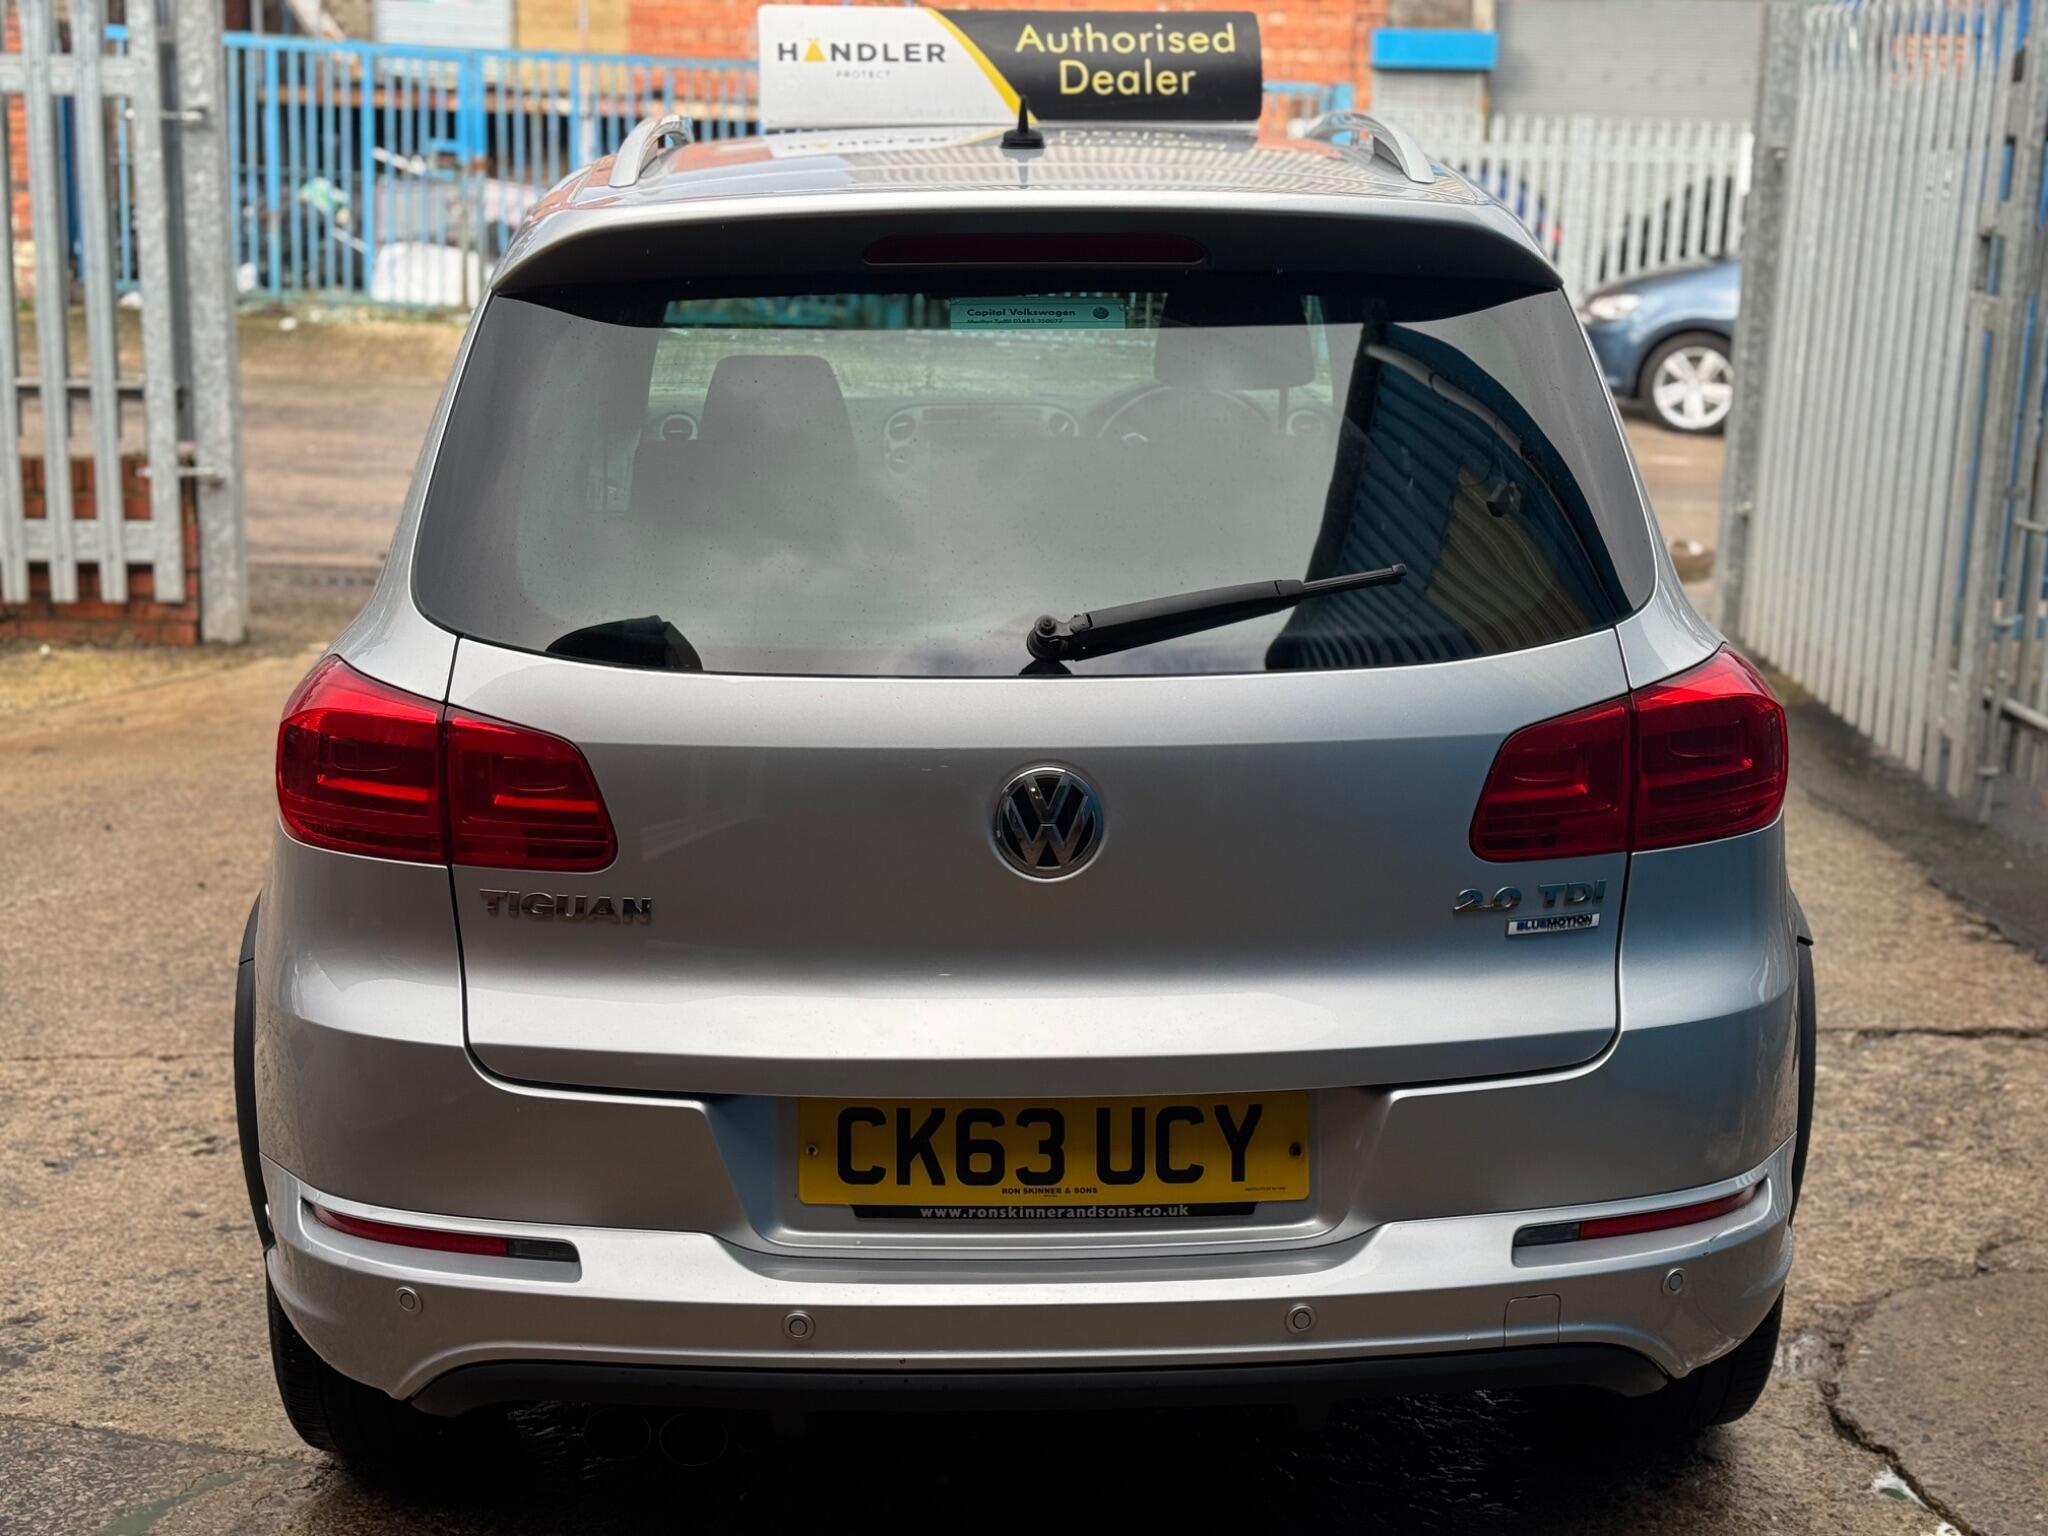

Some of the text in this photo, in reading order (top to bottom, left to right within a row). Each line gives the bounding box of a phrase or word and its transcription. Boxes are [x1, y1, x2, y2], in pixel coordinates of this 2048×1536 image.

[1015, 24, 1236, 54] Authorised
[835, 70, 891, 80] PROTECT
[1058, 59, 1196, 95] Dealer
[967, 309, 1076, 317] Capitol Volkswagen
[480, 889, 652, 924] TIGUAN
[1454, 880, 1607, 912] 2.0 TDI
[1516, 914, 1593, 931] BLUEMOTION
[837, 1104, 1263, 1186] CK63 UCY
[920, 1205, 1189, 1218] www.ronskinnerandsons.co.uk
